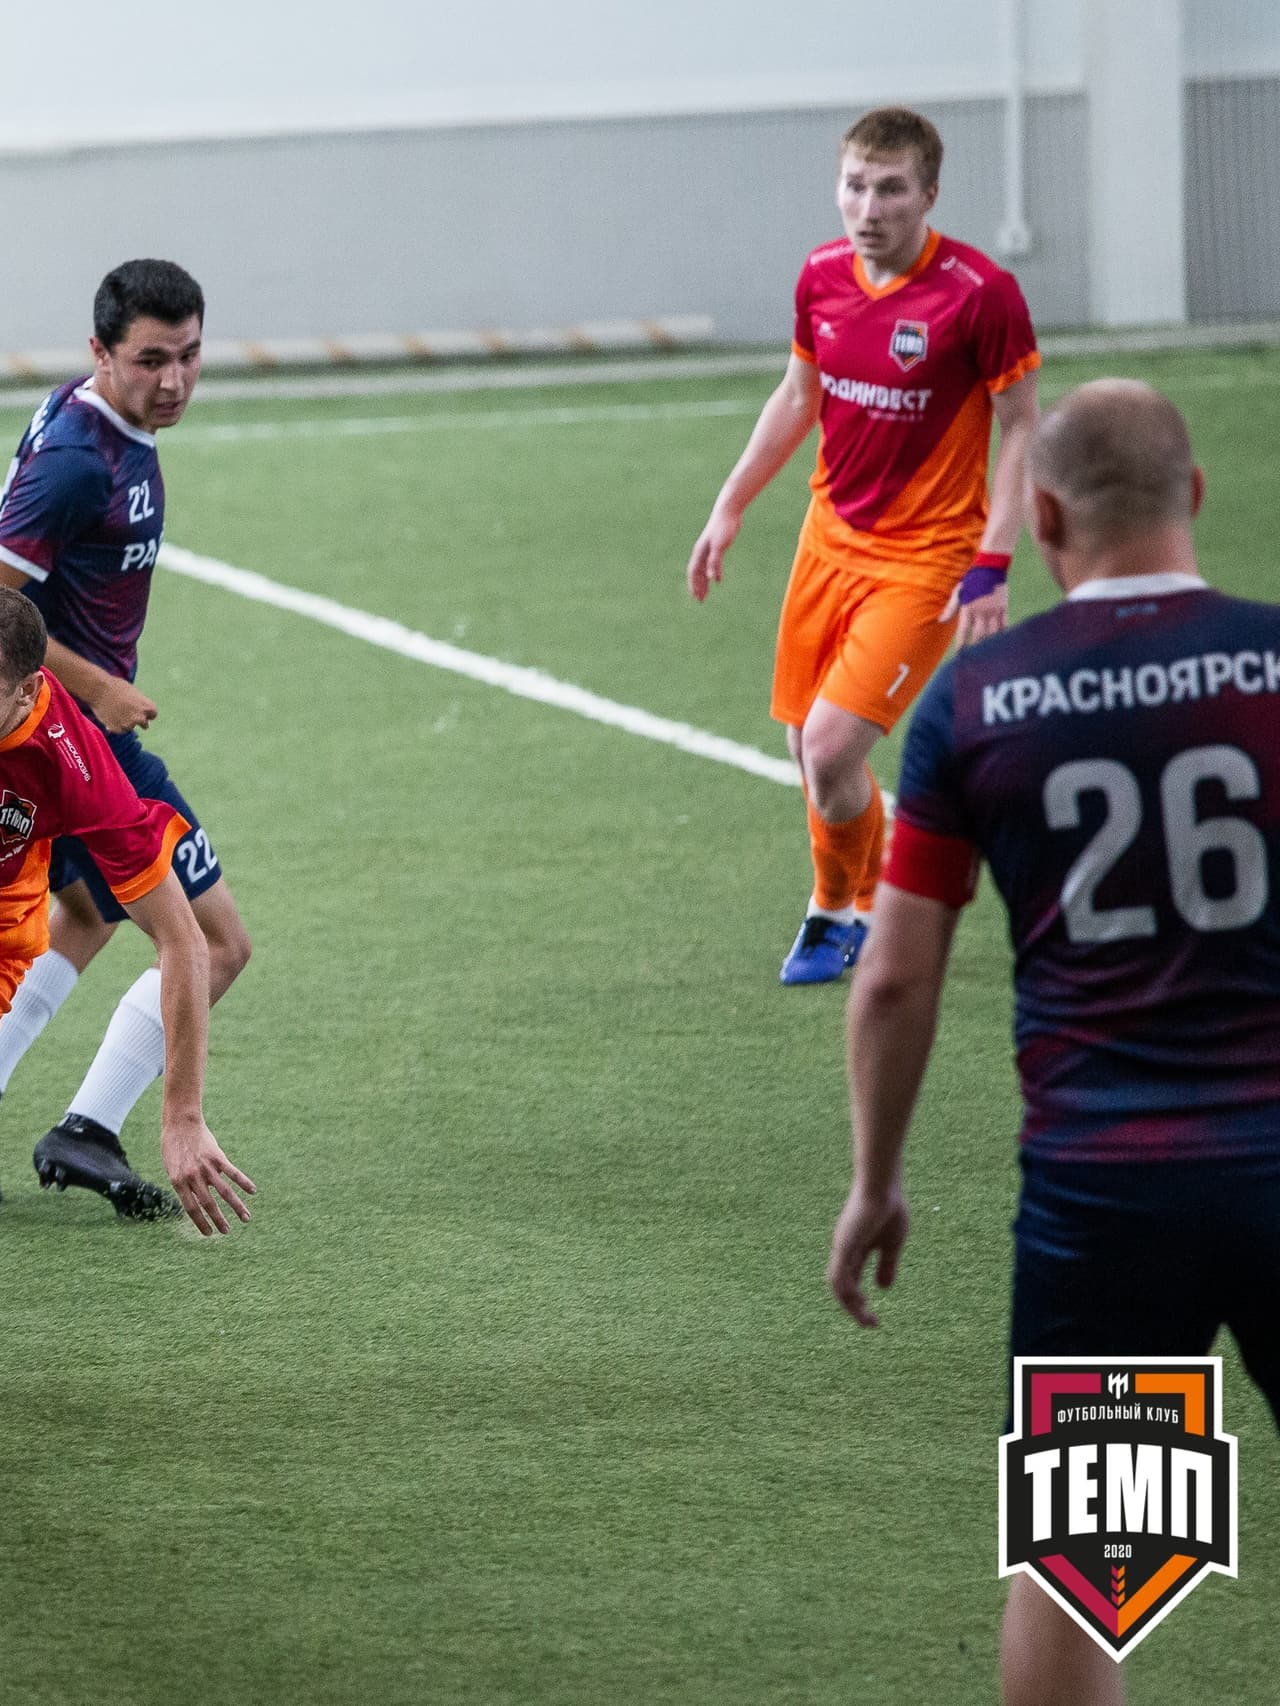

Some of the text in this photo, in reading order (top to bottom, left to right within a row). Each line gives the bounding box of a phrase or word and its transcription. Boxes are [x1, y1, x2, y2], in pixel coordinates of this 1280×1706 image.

[128, 480, 155, 523] 22
[121, 536, 162, 571] РА
[0, 807, 30, 834] ТЕМП
[178, 828, 217, 883] 22
[1042, 744, 1269, 943] 26
